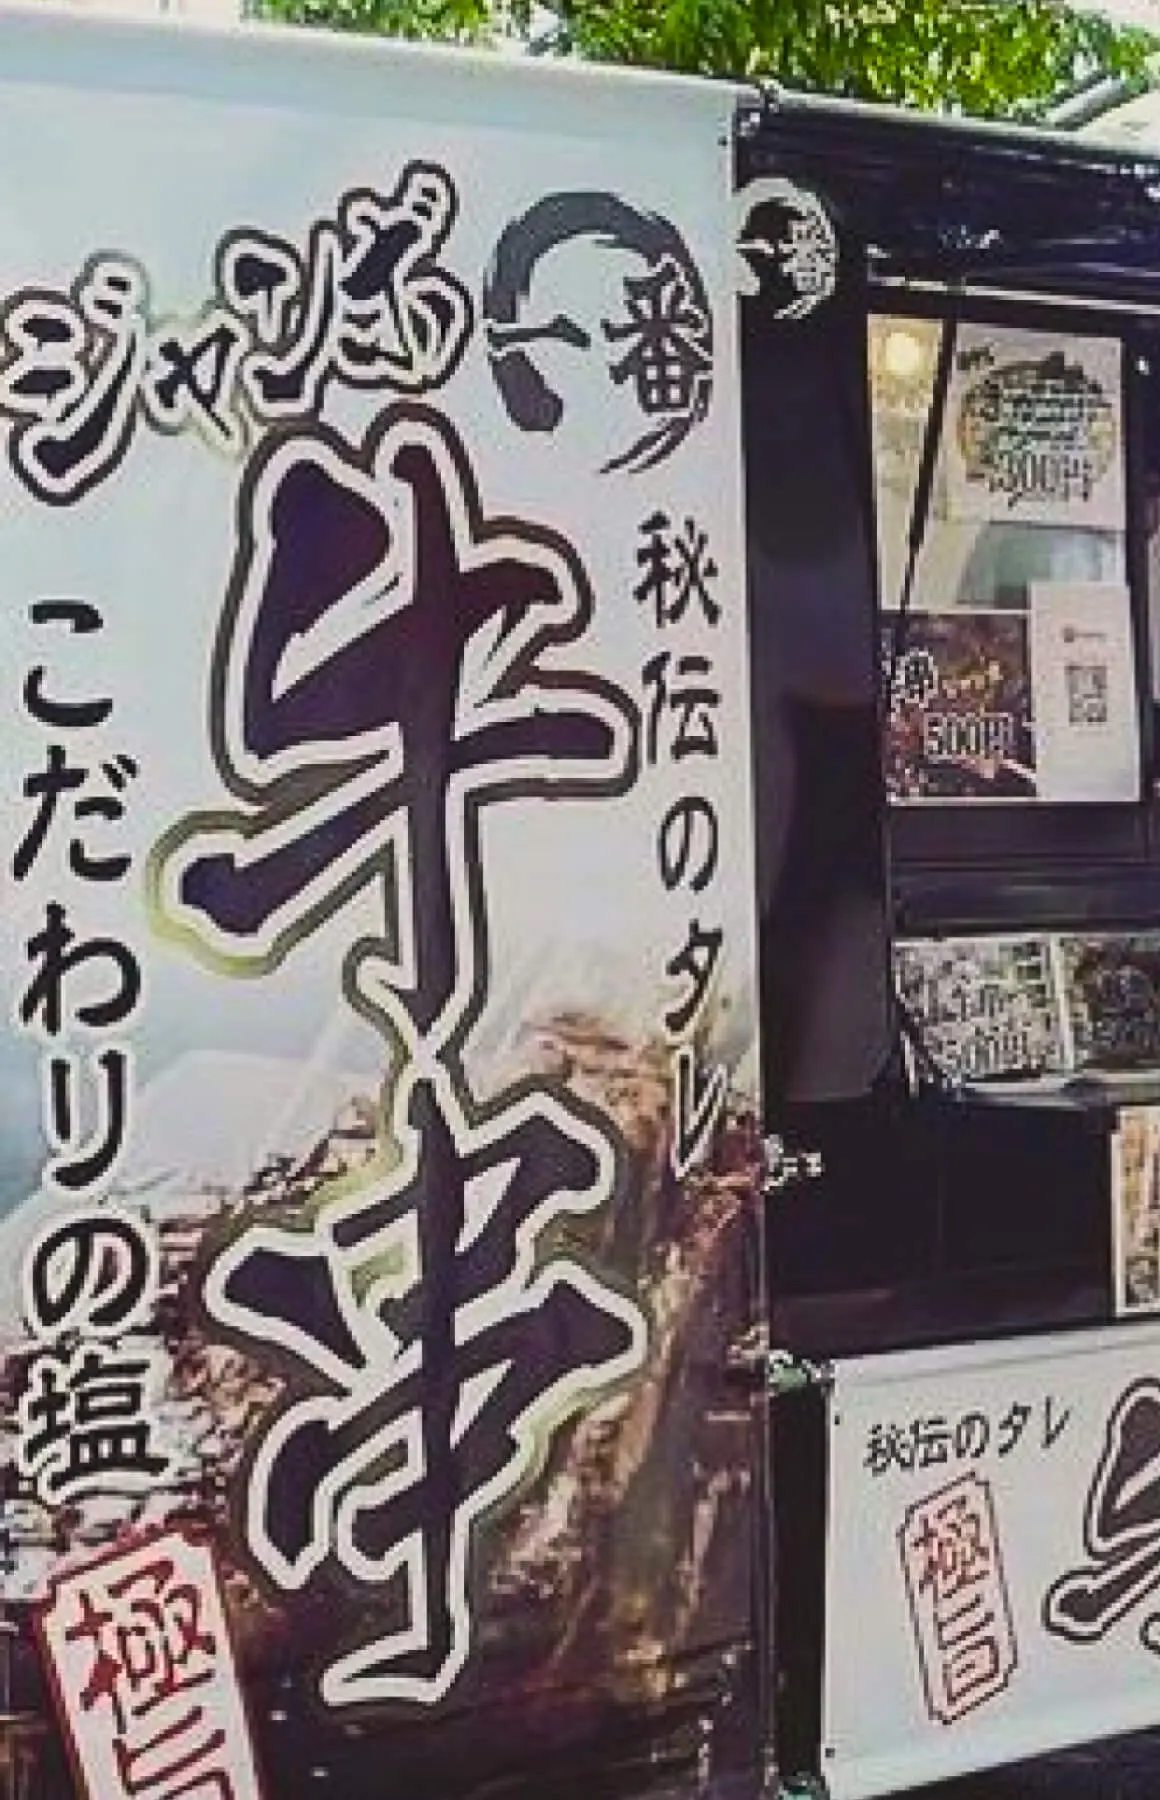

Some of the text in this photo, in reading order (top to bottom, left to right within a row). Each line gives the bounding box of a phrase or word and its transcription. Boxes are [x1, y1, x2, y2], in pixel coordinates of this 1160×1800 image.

[0, 160, 472, 505] ジャンボ
[484, 245, 713, 418] 一番
[13, 600, 169, 1488] こだわりの塩
[148, 402, 650, 1706] 牛串
[633, 511, 727, 1170] 秘伝のタレ
[863, 1396, 1070, 1477] 秘伝のタレ
